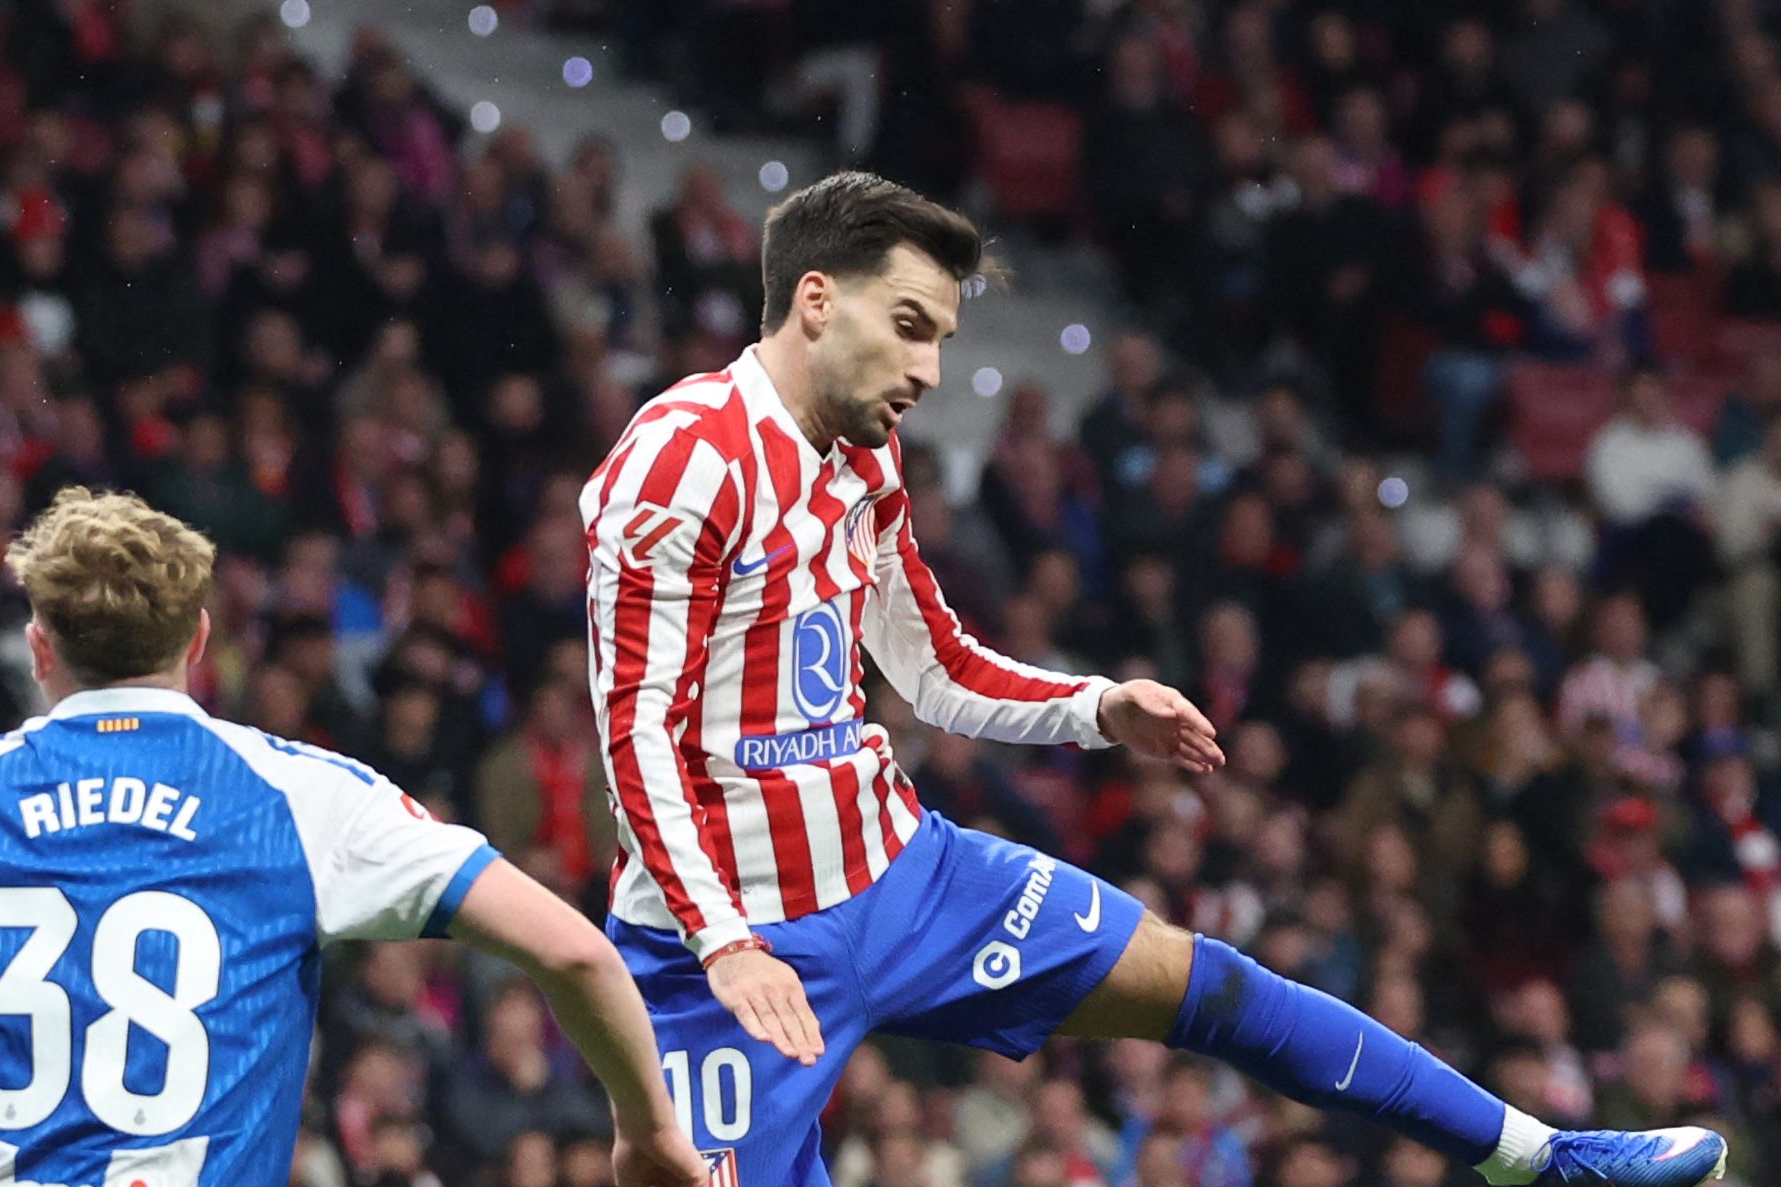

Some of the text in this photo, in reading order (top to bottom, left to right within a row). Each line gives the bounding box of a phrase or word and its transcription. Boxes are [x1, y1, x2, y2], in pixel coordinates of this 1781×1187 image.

[743, 728, 836, 766] RIYADH
[19, 777, 201, 841] RIEDEL
[662, 1047, 752, 1142] 10
